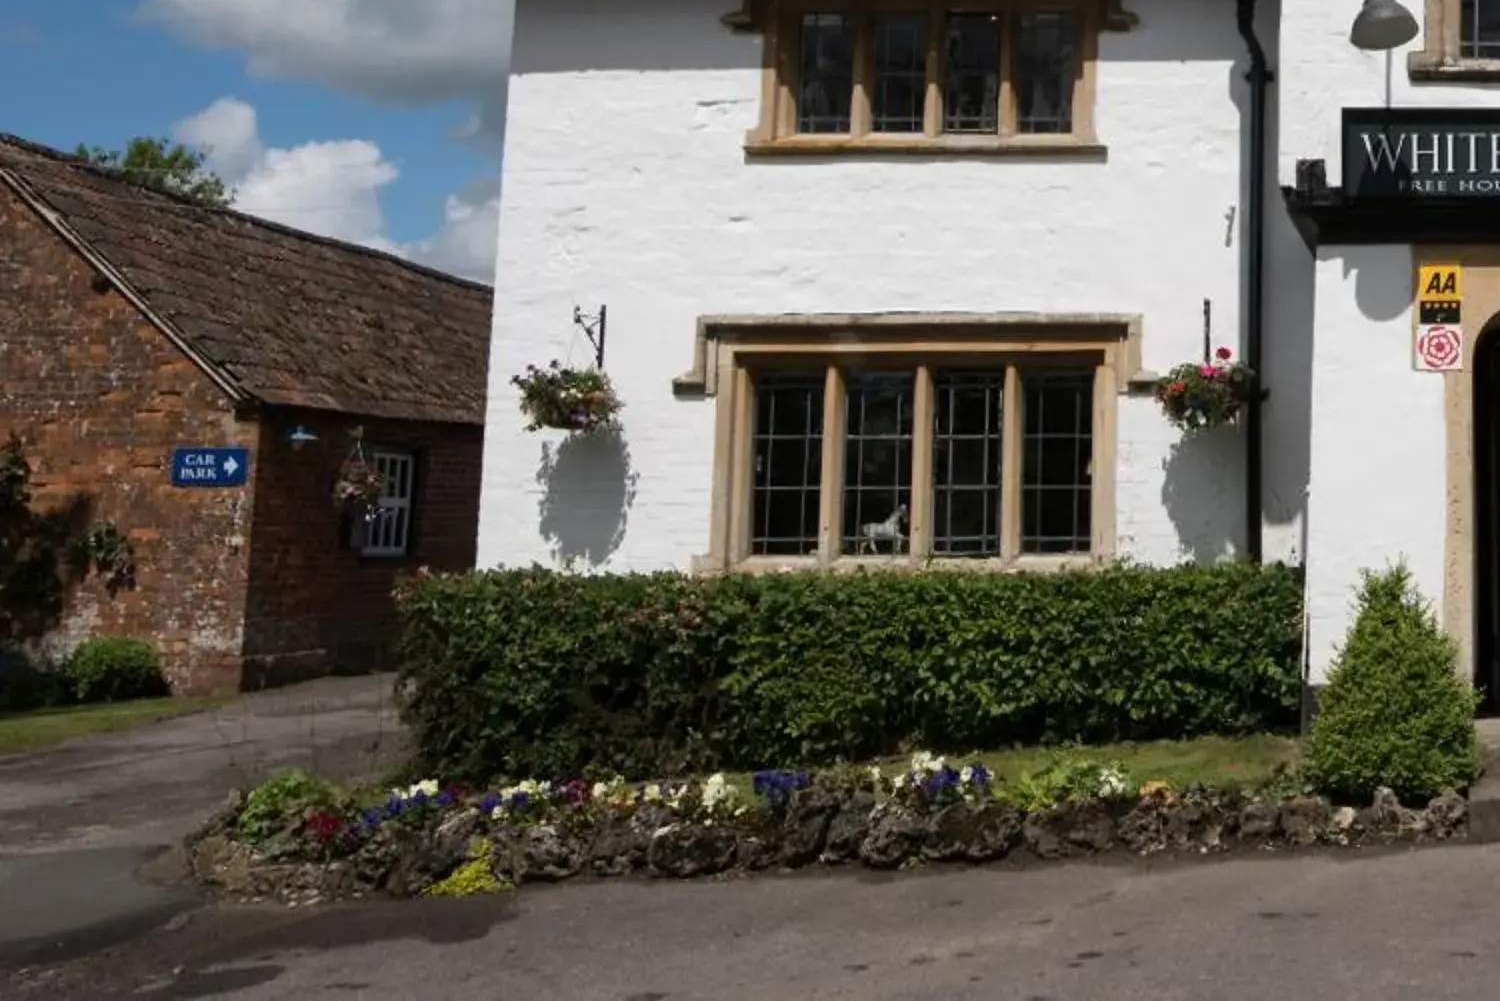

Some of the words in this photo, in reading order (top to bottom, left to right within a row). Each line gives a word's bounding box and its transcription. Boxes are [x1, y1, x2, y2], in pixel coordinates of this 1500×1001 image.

[1397, 179, 1448, 193] FREE
[1425, 271, 1456, 294] AA
[185, 454, 216, 466] CAR
[181, 467, 217, 480] PARK
